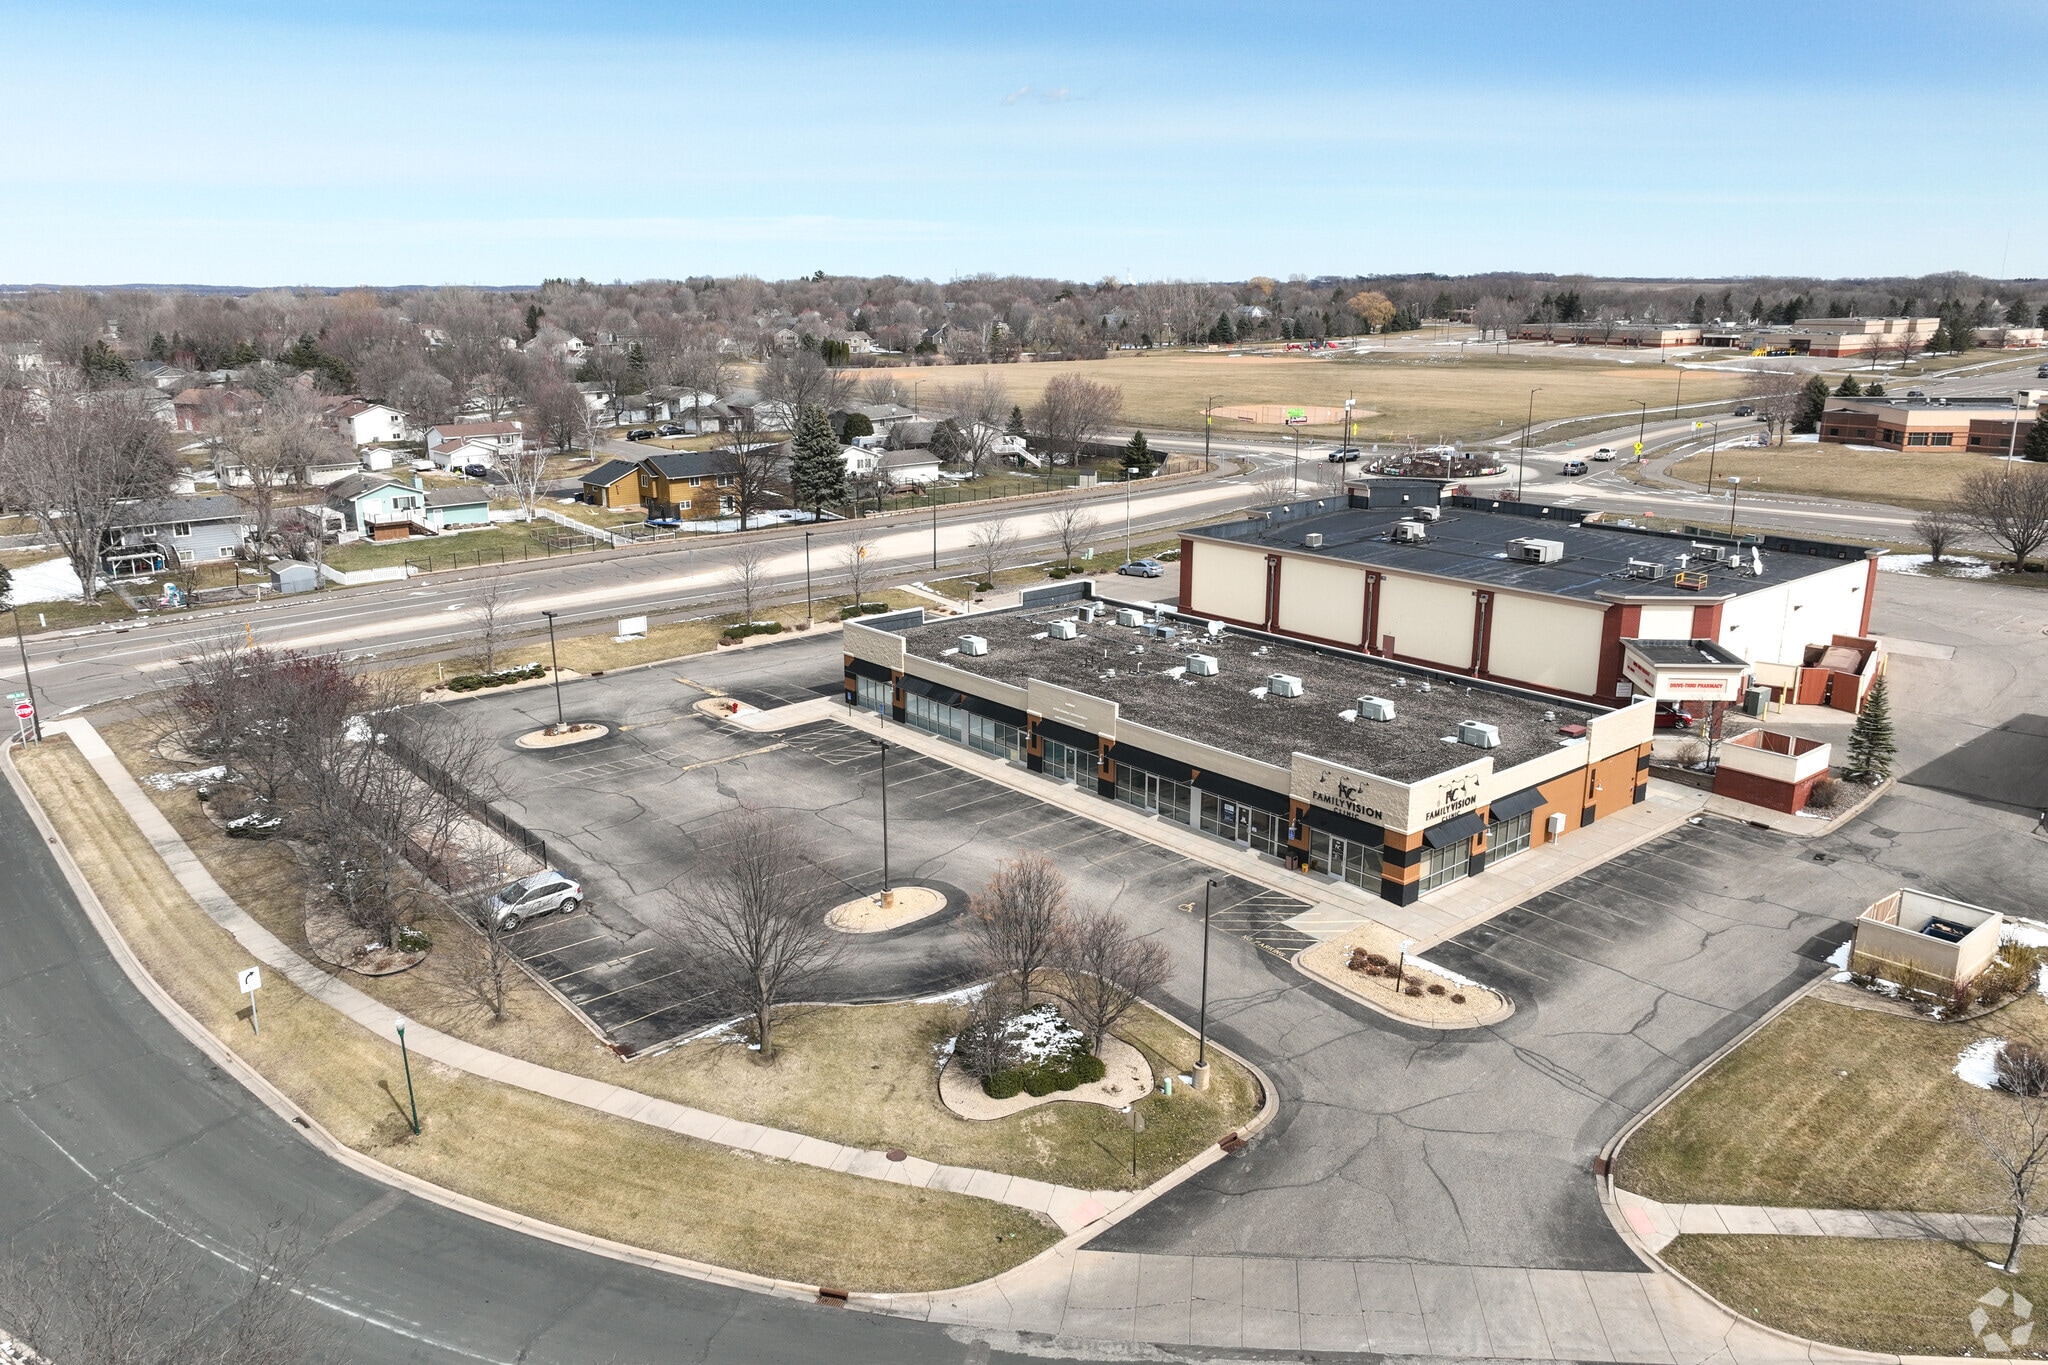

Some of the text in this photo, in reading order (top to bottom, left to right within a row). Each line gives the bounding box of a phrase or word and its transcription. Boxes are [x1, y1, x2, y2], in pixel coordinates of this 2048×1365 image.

[16, 707, 33, 715] STOP
[1312, 790, 1382, 820] FAMILY VISION
[1425, 794, 1477, 821] FAMILY VISION
[1254, 940, 1286, 957] PARKING
